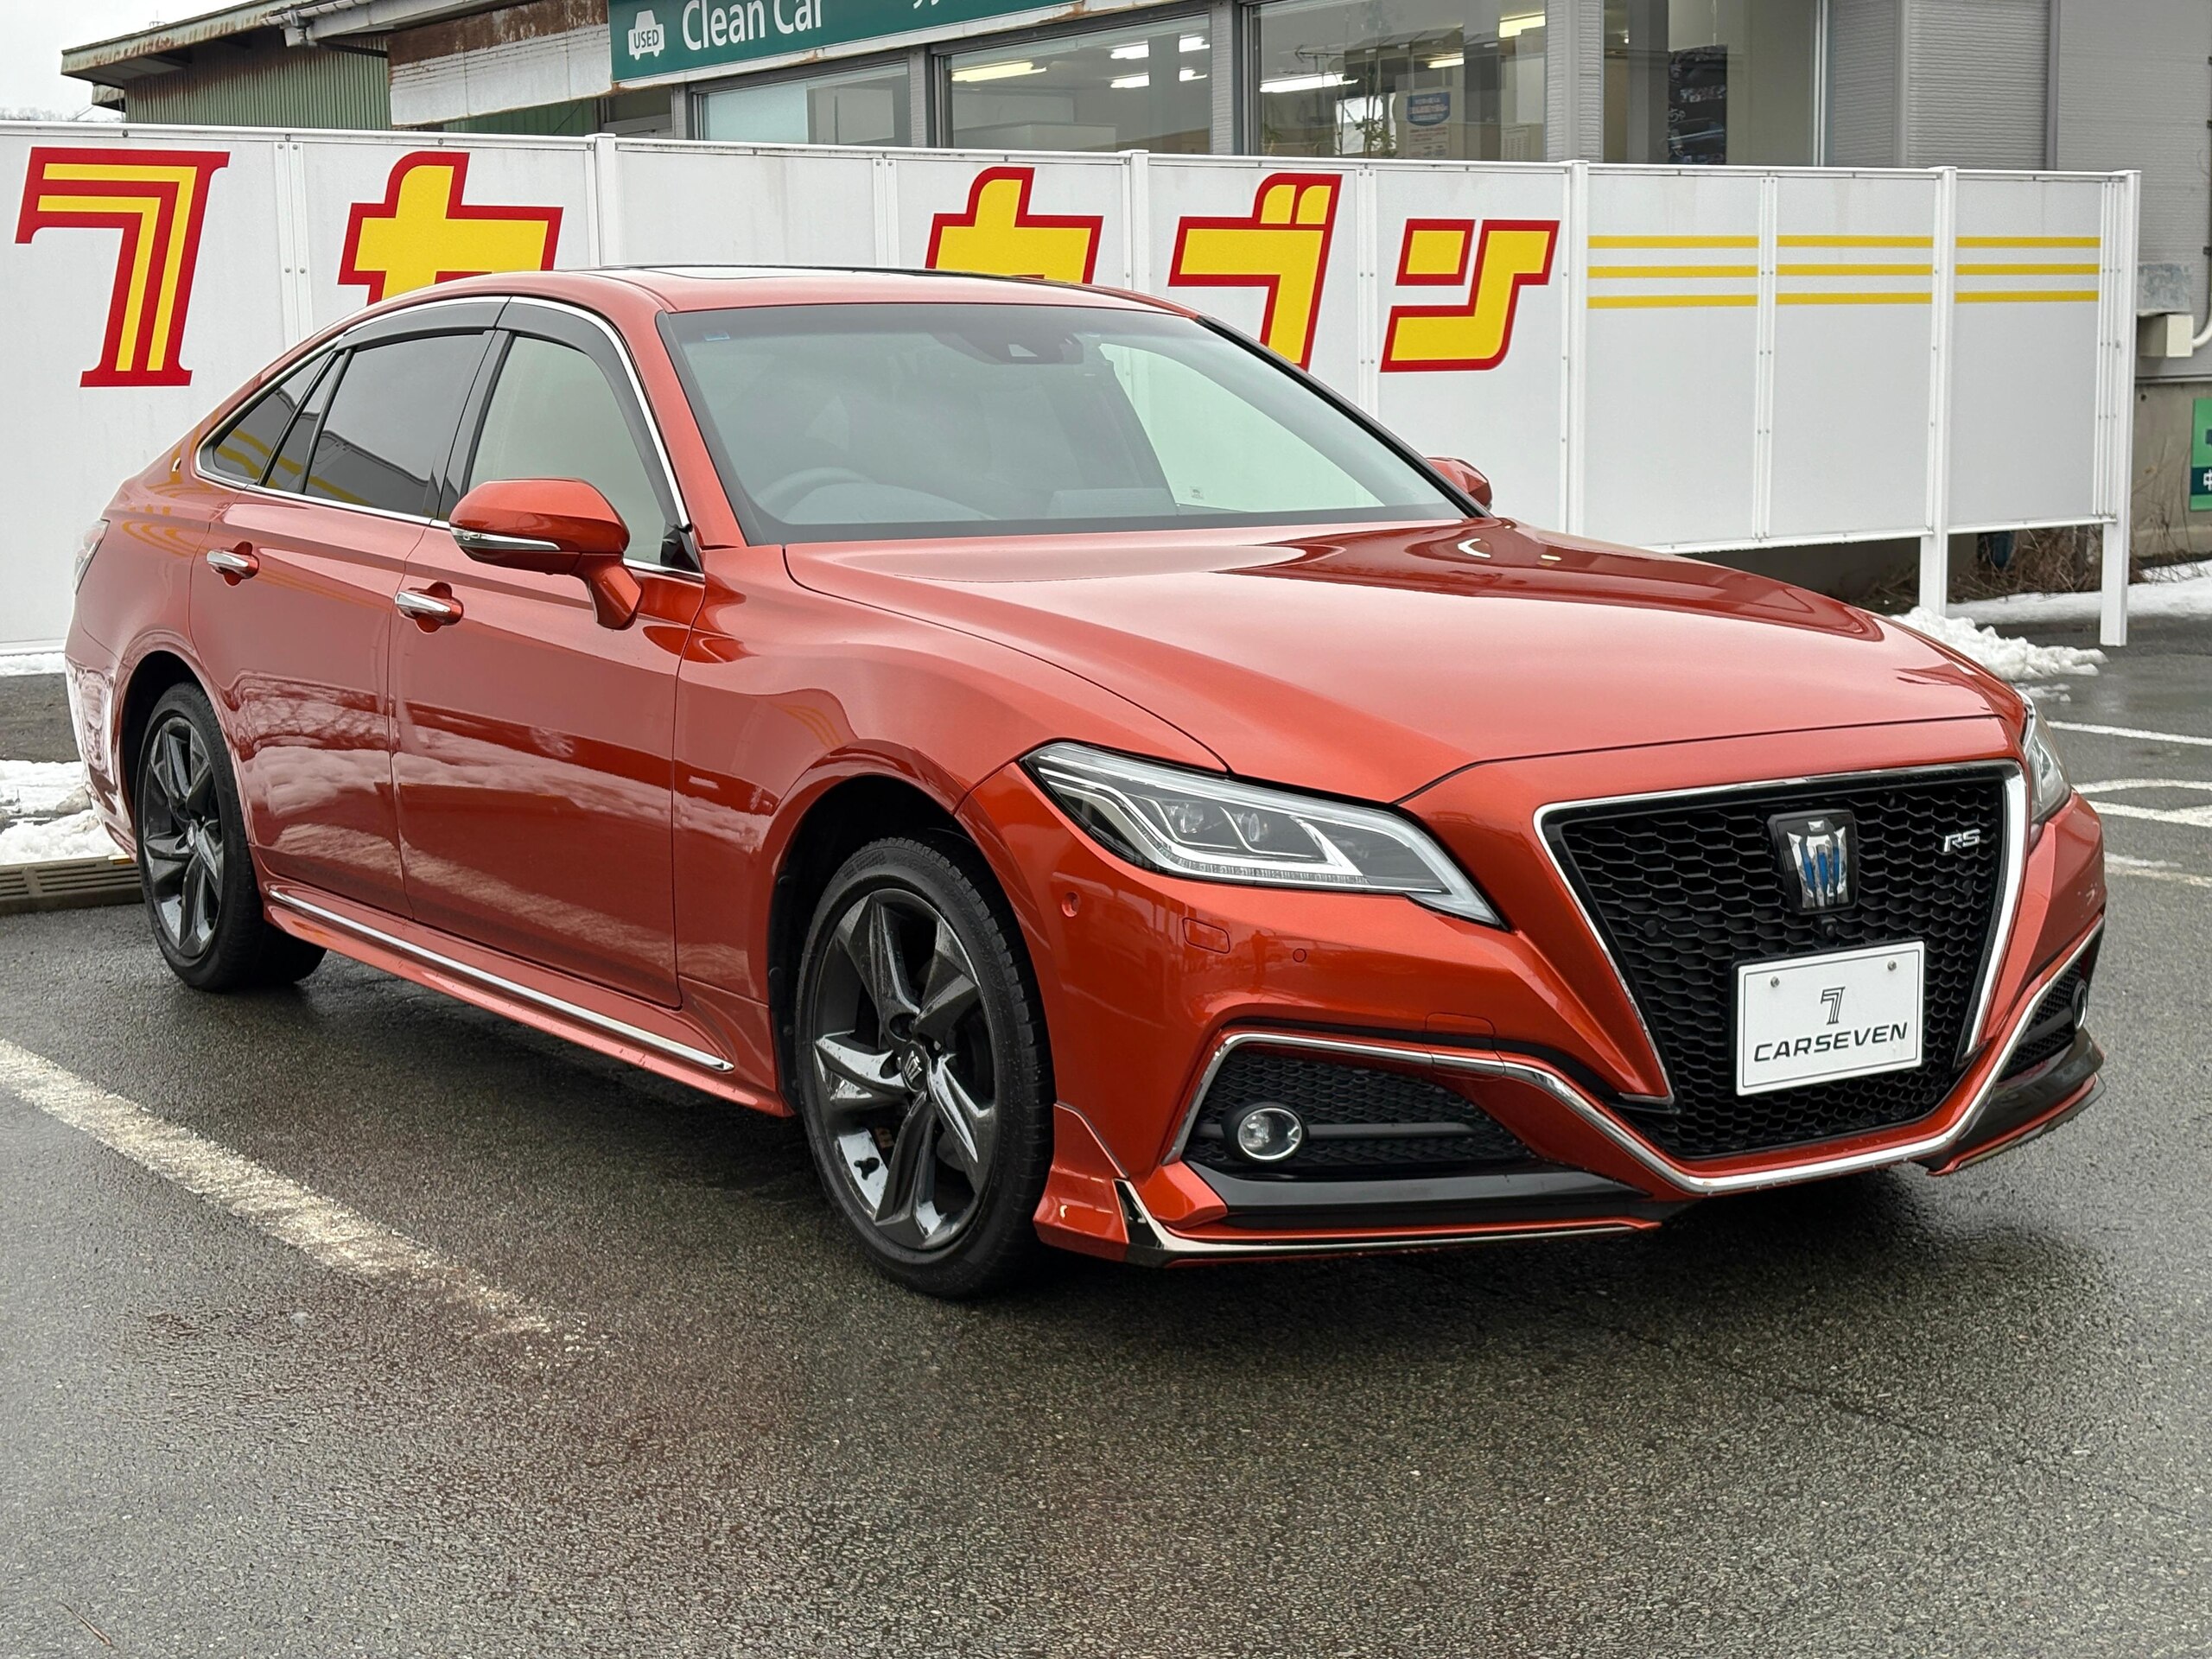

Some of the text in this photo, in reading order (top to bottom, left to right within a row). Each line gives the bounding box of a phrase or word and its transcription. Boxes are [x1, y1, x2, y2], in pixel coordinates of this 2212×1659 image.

[633, 29, 659, 49] USED
[682, 0, 822, 50] Clean Car
[1944, 829, 1980, 853] RS
[1754, 1022, 1908, 1062] CARSEVEN
